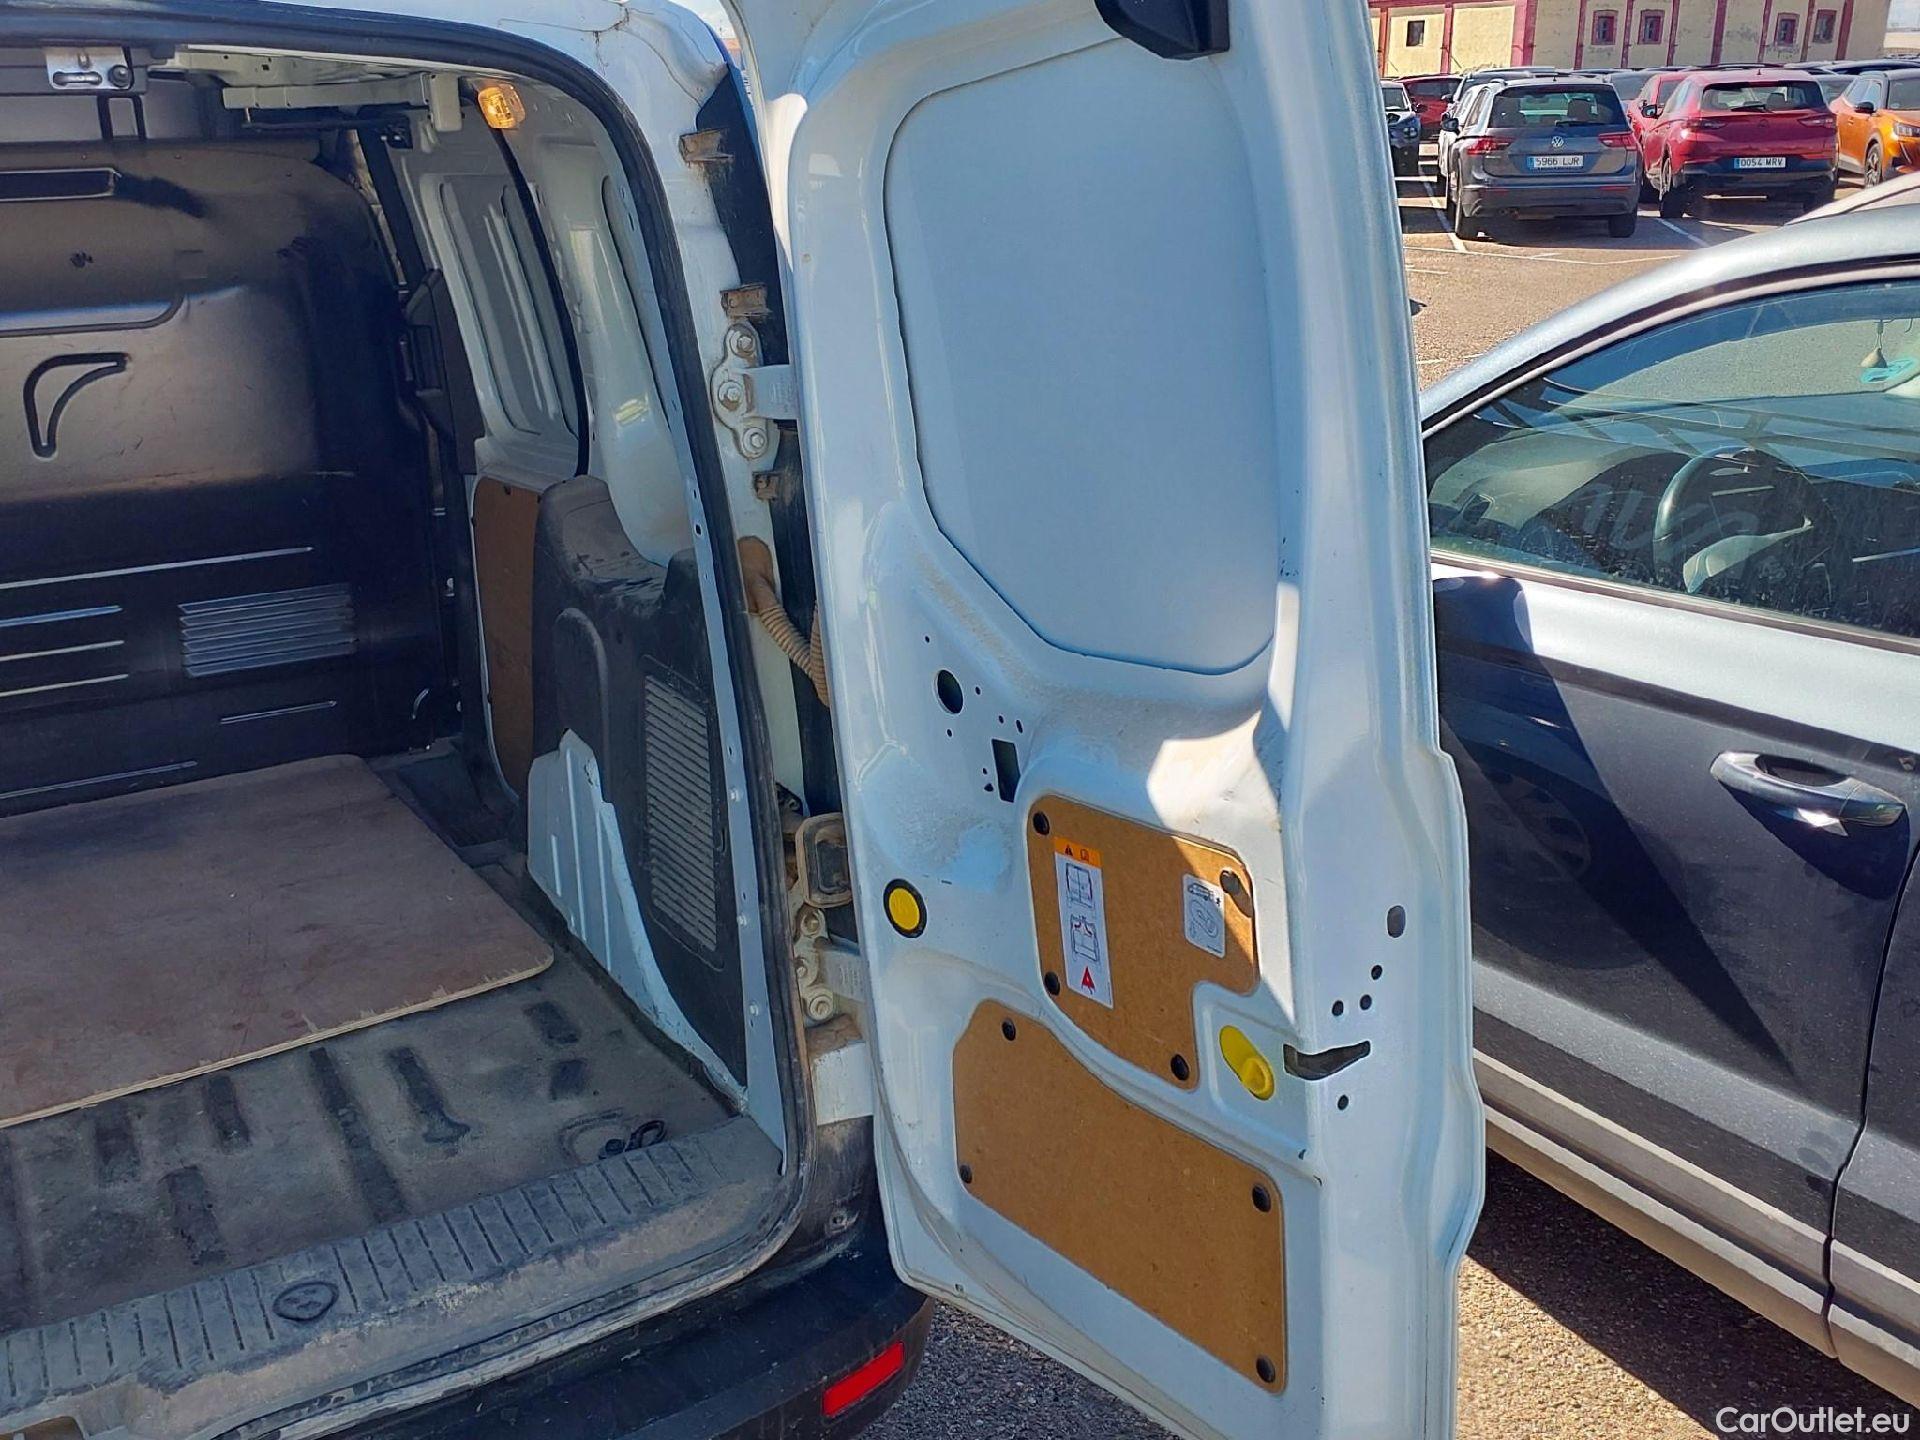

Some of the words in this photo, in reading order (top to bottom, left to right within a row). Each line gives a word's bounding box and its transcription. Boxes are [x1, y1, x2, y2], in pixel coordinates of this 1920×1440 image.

[1536, 157, 1558, 166] 5966
[1562, 156, 1580, 166] LJR
[1740, 158, 1762, 167] 0054
[1765, 157, 1783, 166] MRV
